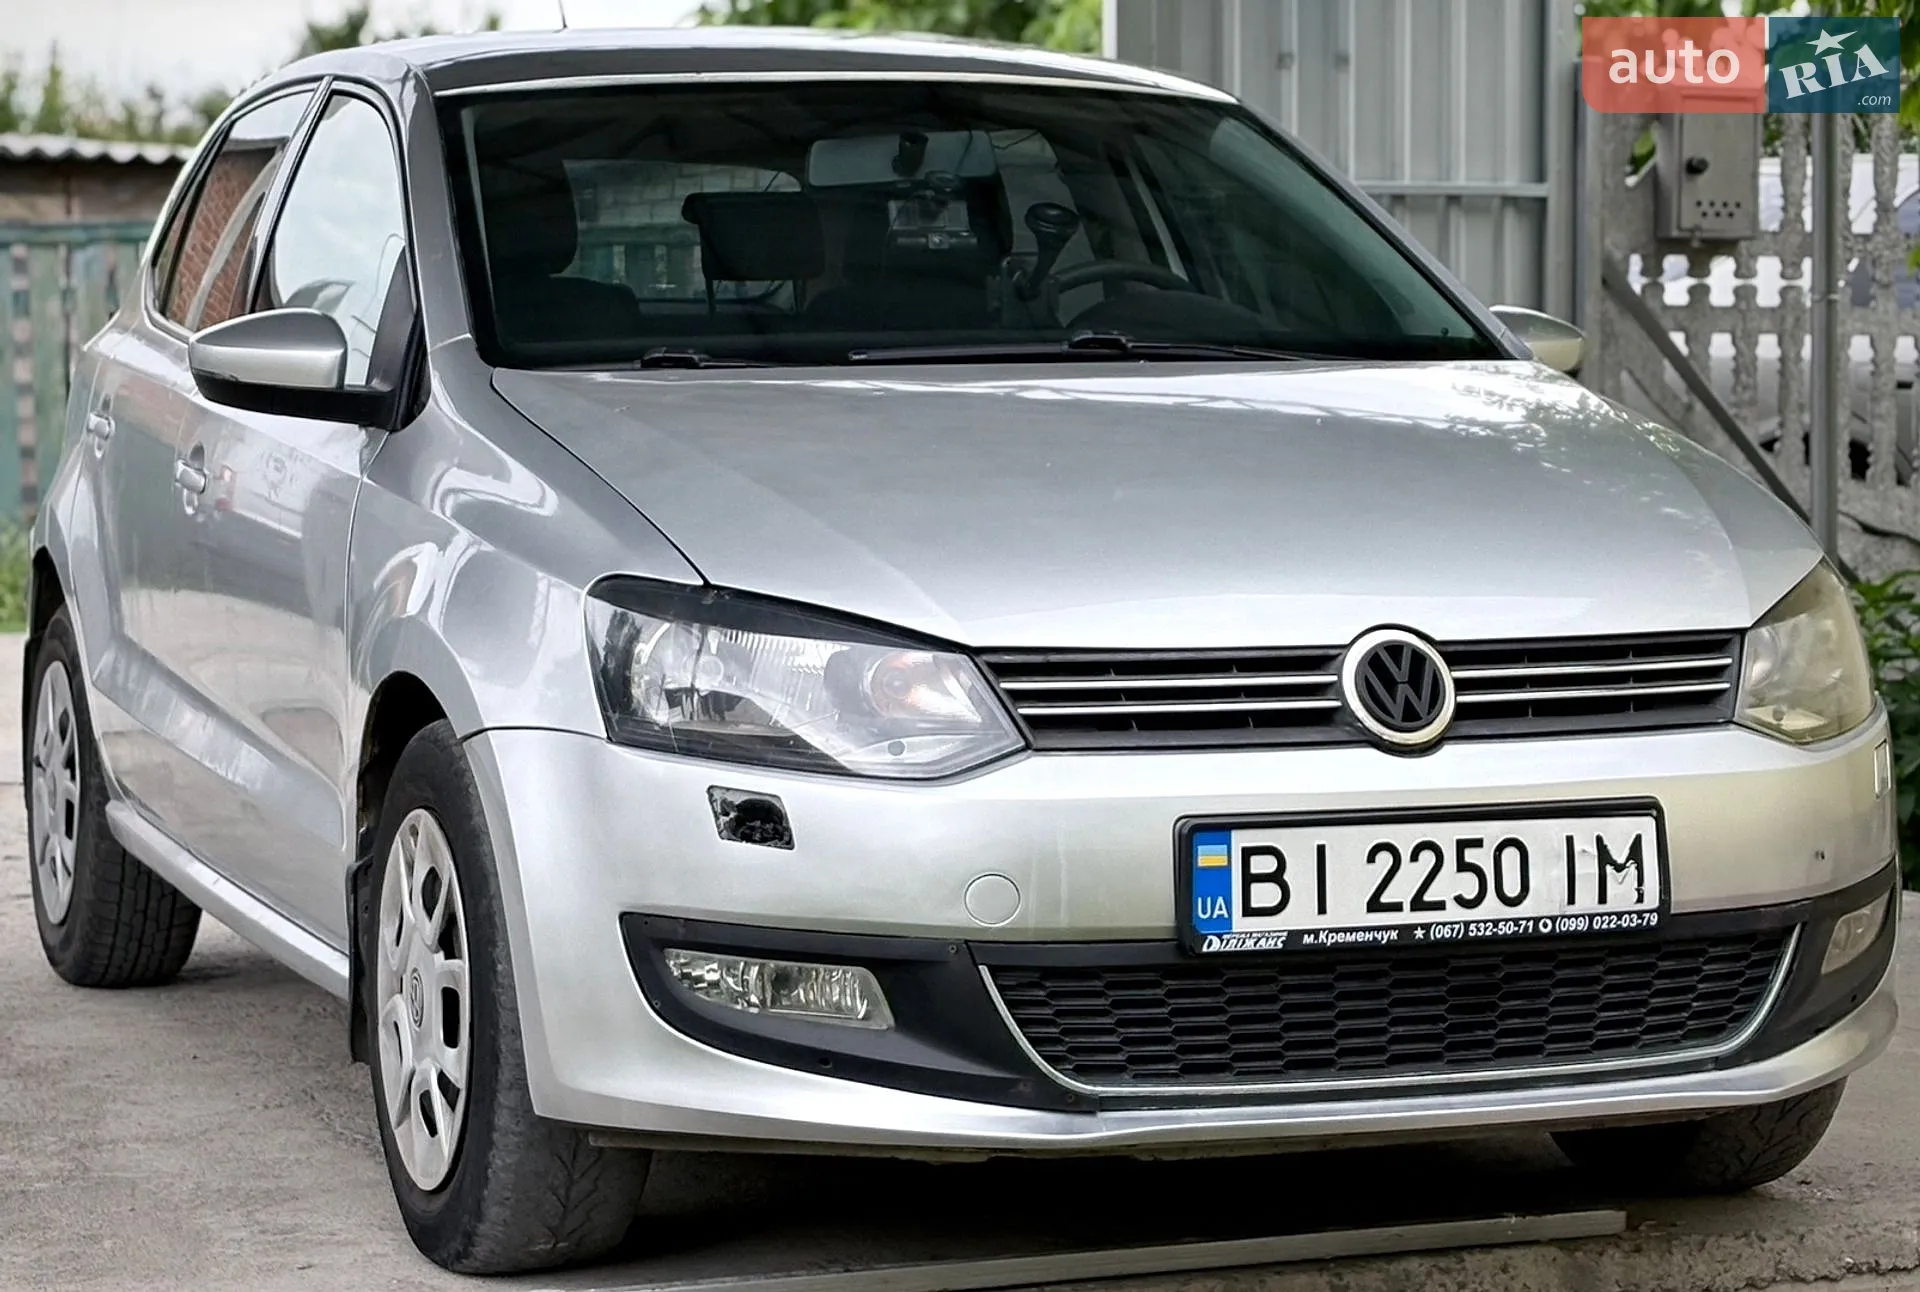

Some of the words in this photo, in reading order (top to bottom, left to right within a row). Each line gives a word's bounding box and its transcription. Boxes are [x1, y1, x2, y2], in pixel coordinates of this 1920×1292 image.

[1356, 639, 1443, 728] VW
[1366, 837, 1530, 914] 2250
[1197, 896, 1229, 920] UA
[1302, 929, 1399, 947] м.Кременчук
[1430, 923, 1464, 940] (067)
[1468, 920, 1534, 937] 532-50-71
[1555, 915, 1589, 932] (099)
[1592, 912, 1658, 930] 022-03-79
